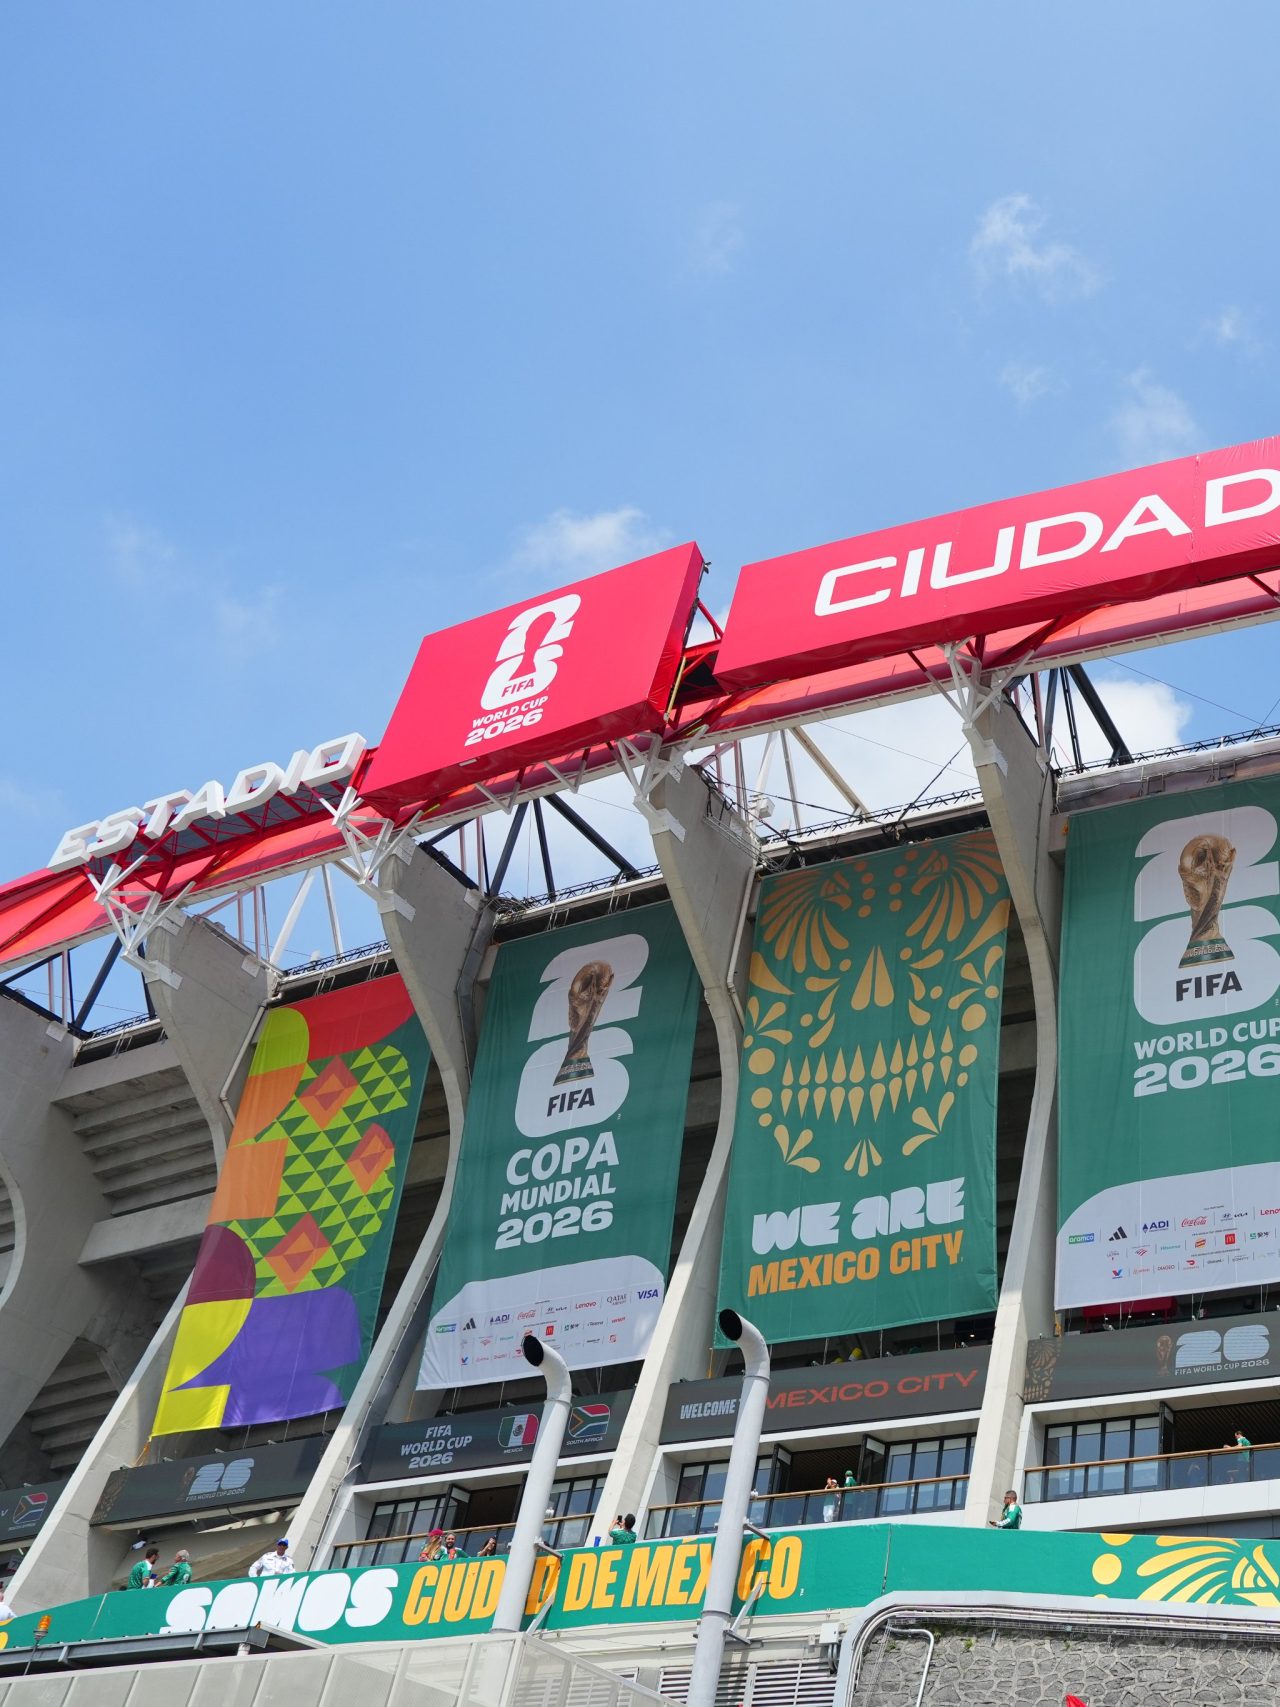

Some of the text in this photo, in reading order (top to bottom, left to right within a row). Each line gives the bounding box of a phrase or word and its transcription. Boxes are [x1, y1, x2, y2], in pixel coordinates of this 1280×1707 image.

[501, 678, 535, 697] FIFA
[464, 708, 543, 746] 2026
[472, 696, 548, 728] WORLD CUP
[47, 732, 366, 873] ESTADIO
[1176, 971, 1242, 1002] FIFA
[1133, 1027, 1228, 1060] WORLD
[547, 1087, 595, 1117] FIFA
[506, 1131, 619, 1186] COPA
[500, 1174, 616, 1216] MUNDIAL
[494, 1201, 614, 1250] 2026
[752, 1202, 840, 1255] WE
[1069, 1234, 1094, 1243] aramco
[1149, 1220, 1169, 1229] ADI
[747, 1230, 964, 1297] MEXICO CITY
[637, 1289, 659, 1300] VISA
[1175, 1367, 1191, 1375] FIFA
[1193, 1365, 1222, 1373] WORLD
[1241, 1358, 1269, 1368] 2026
[680, 1369, 978, 1420] WELCOME MEXICO CITY
[400, 1435, 473, 1457] WORLD CUP
[425, 1425, 452, 1439] FIFA
[408, 1452, 453, 1469] 2026
[159, 1536, 803, 1634] SOMOS CIUDD DE MÉXCO
